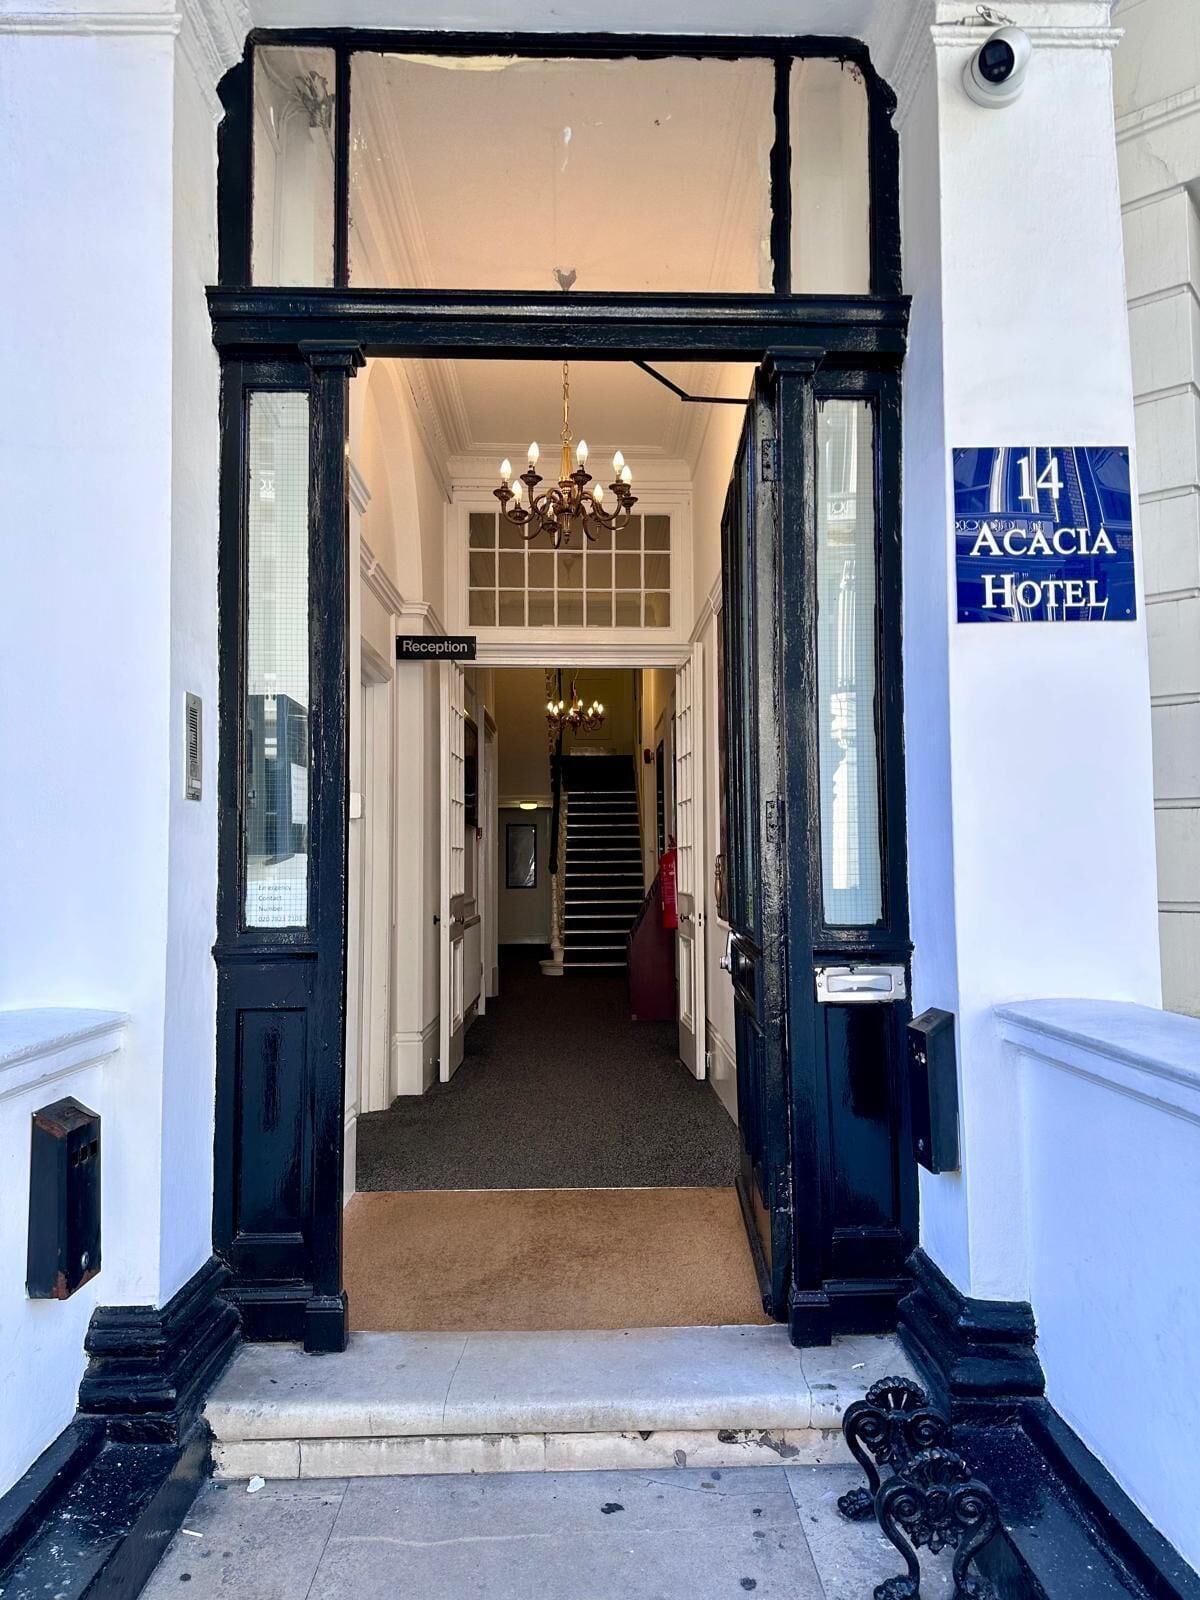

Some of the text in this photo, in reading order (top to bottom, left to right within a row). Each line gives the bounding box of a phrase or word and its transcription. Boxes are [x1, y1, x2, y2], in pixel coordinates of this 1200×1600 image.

[1016, 456, 1064, 500] 14
[969, 522, 1117, 556] ACACIA
[981, 573, 1109, 609] HOTEL
[402, 640, 468, 655] Reception
